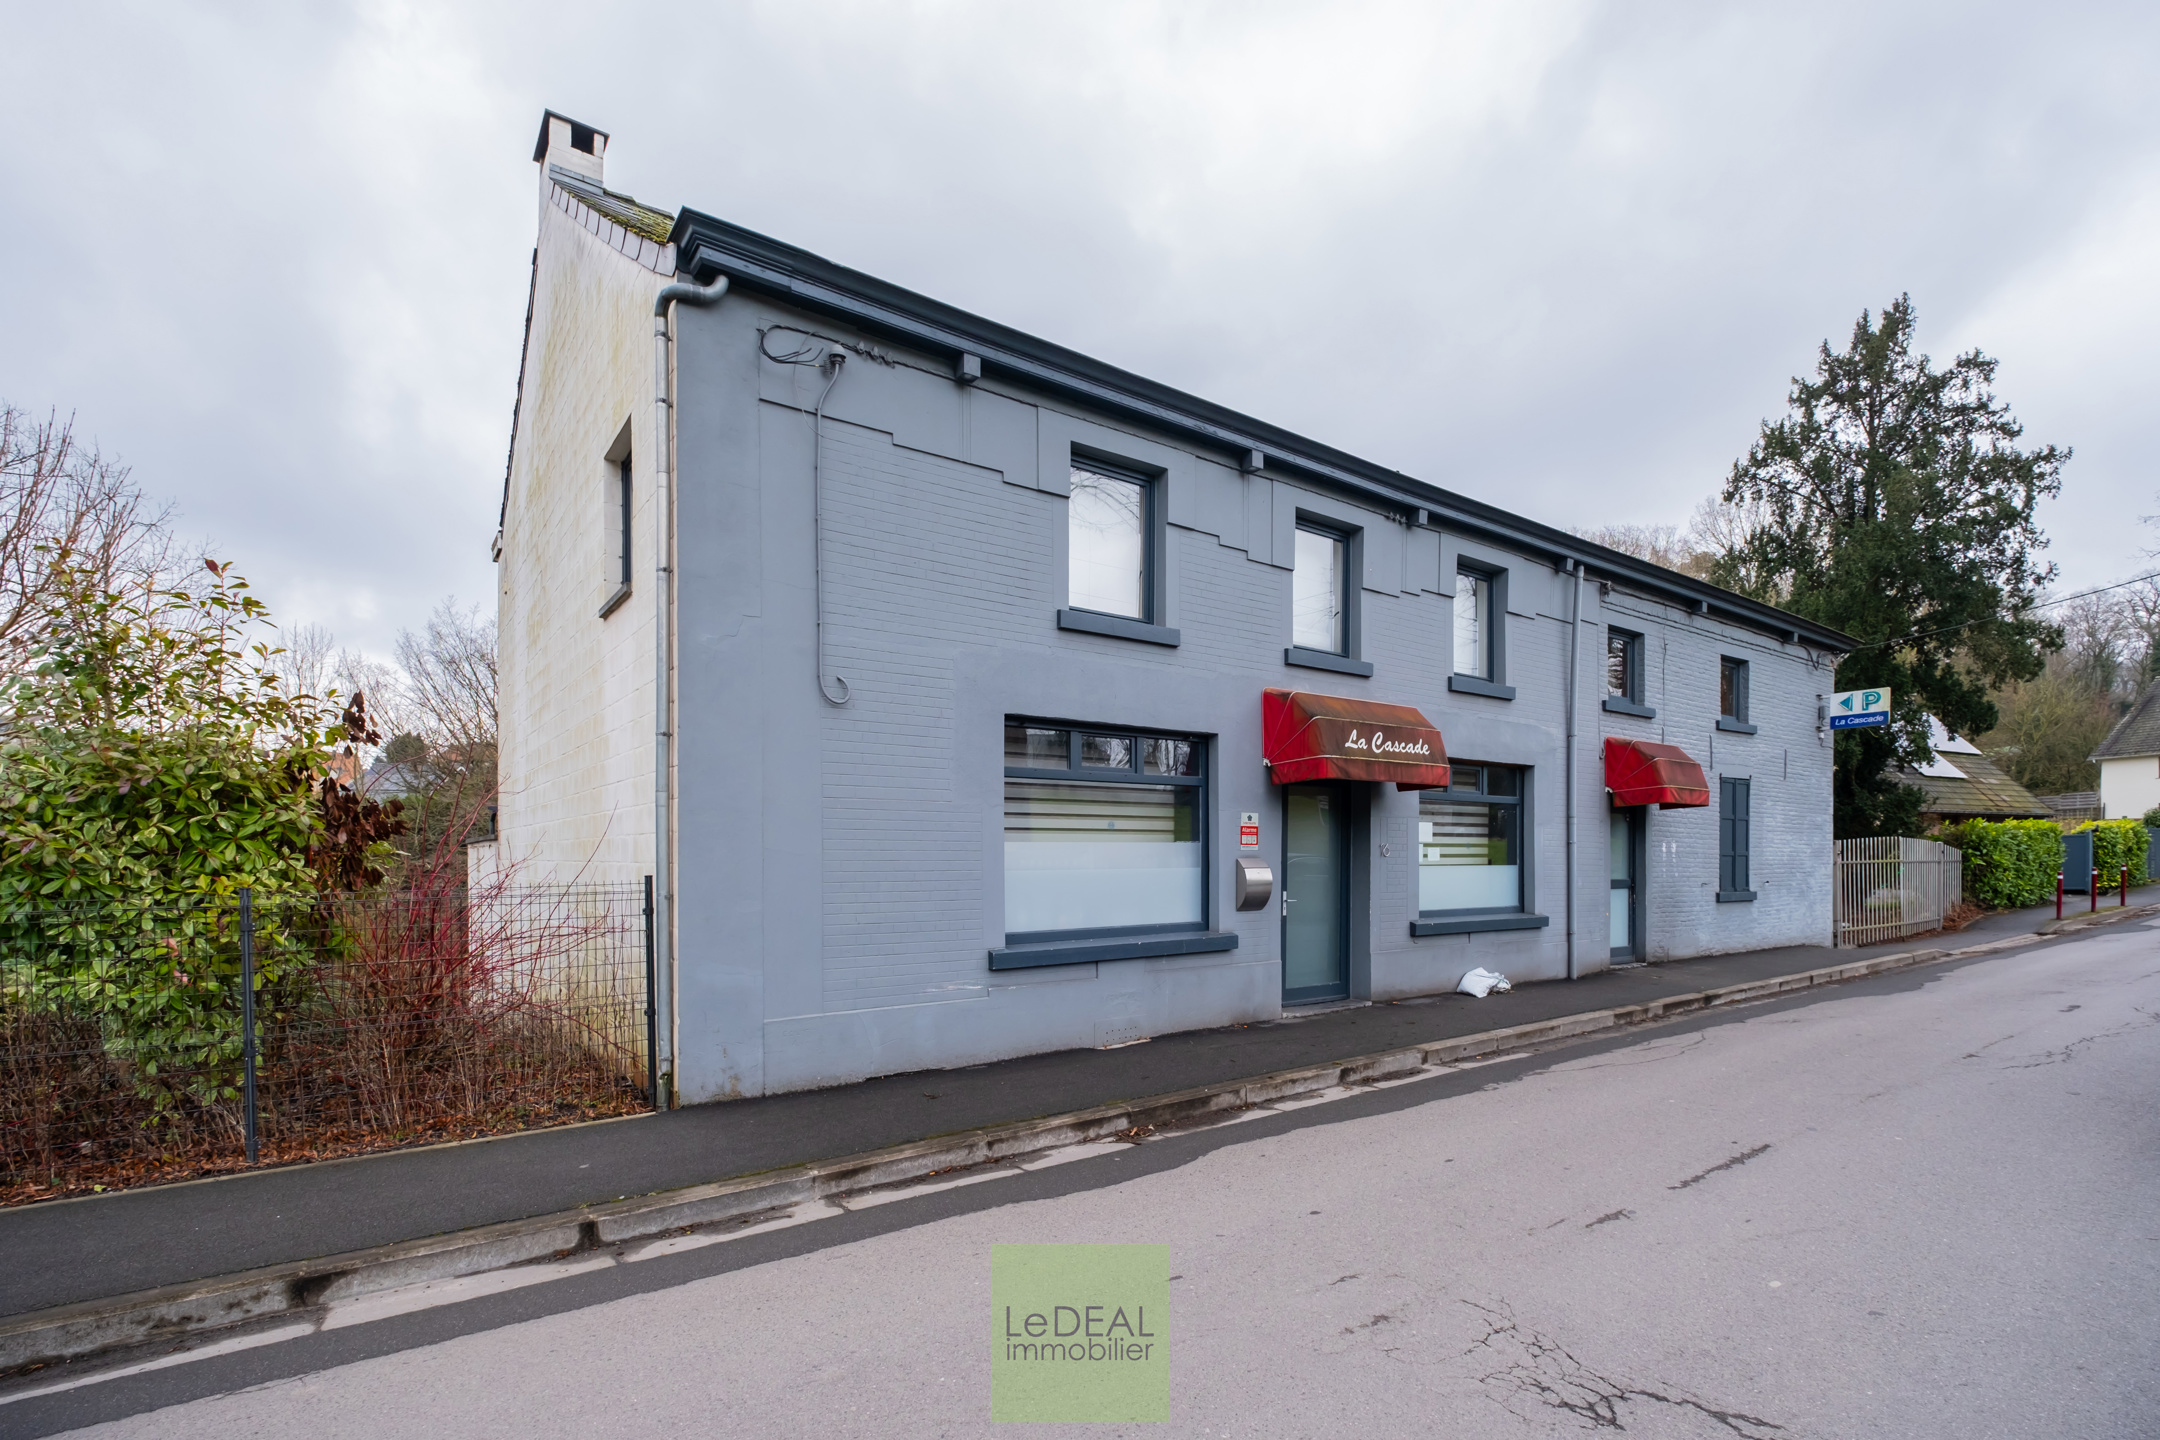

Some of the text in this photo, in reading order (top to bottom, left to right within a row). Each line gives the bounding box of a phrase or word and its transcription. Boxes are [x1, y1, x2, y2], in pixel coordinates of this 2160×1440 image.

[1862, 691, 1882, 711] P
[1835, 714, 1884, 726] La Cascade
[1344, 728, 1431, 755] La Cascade
